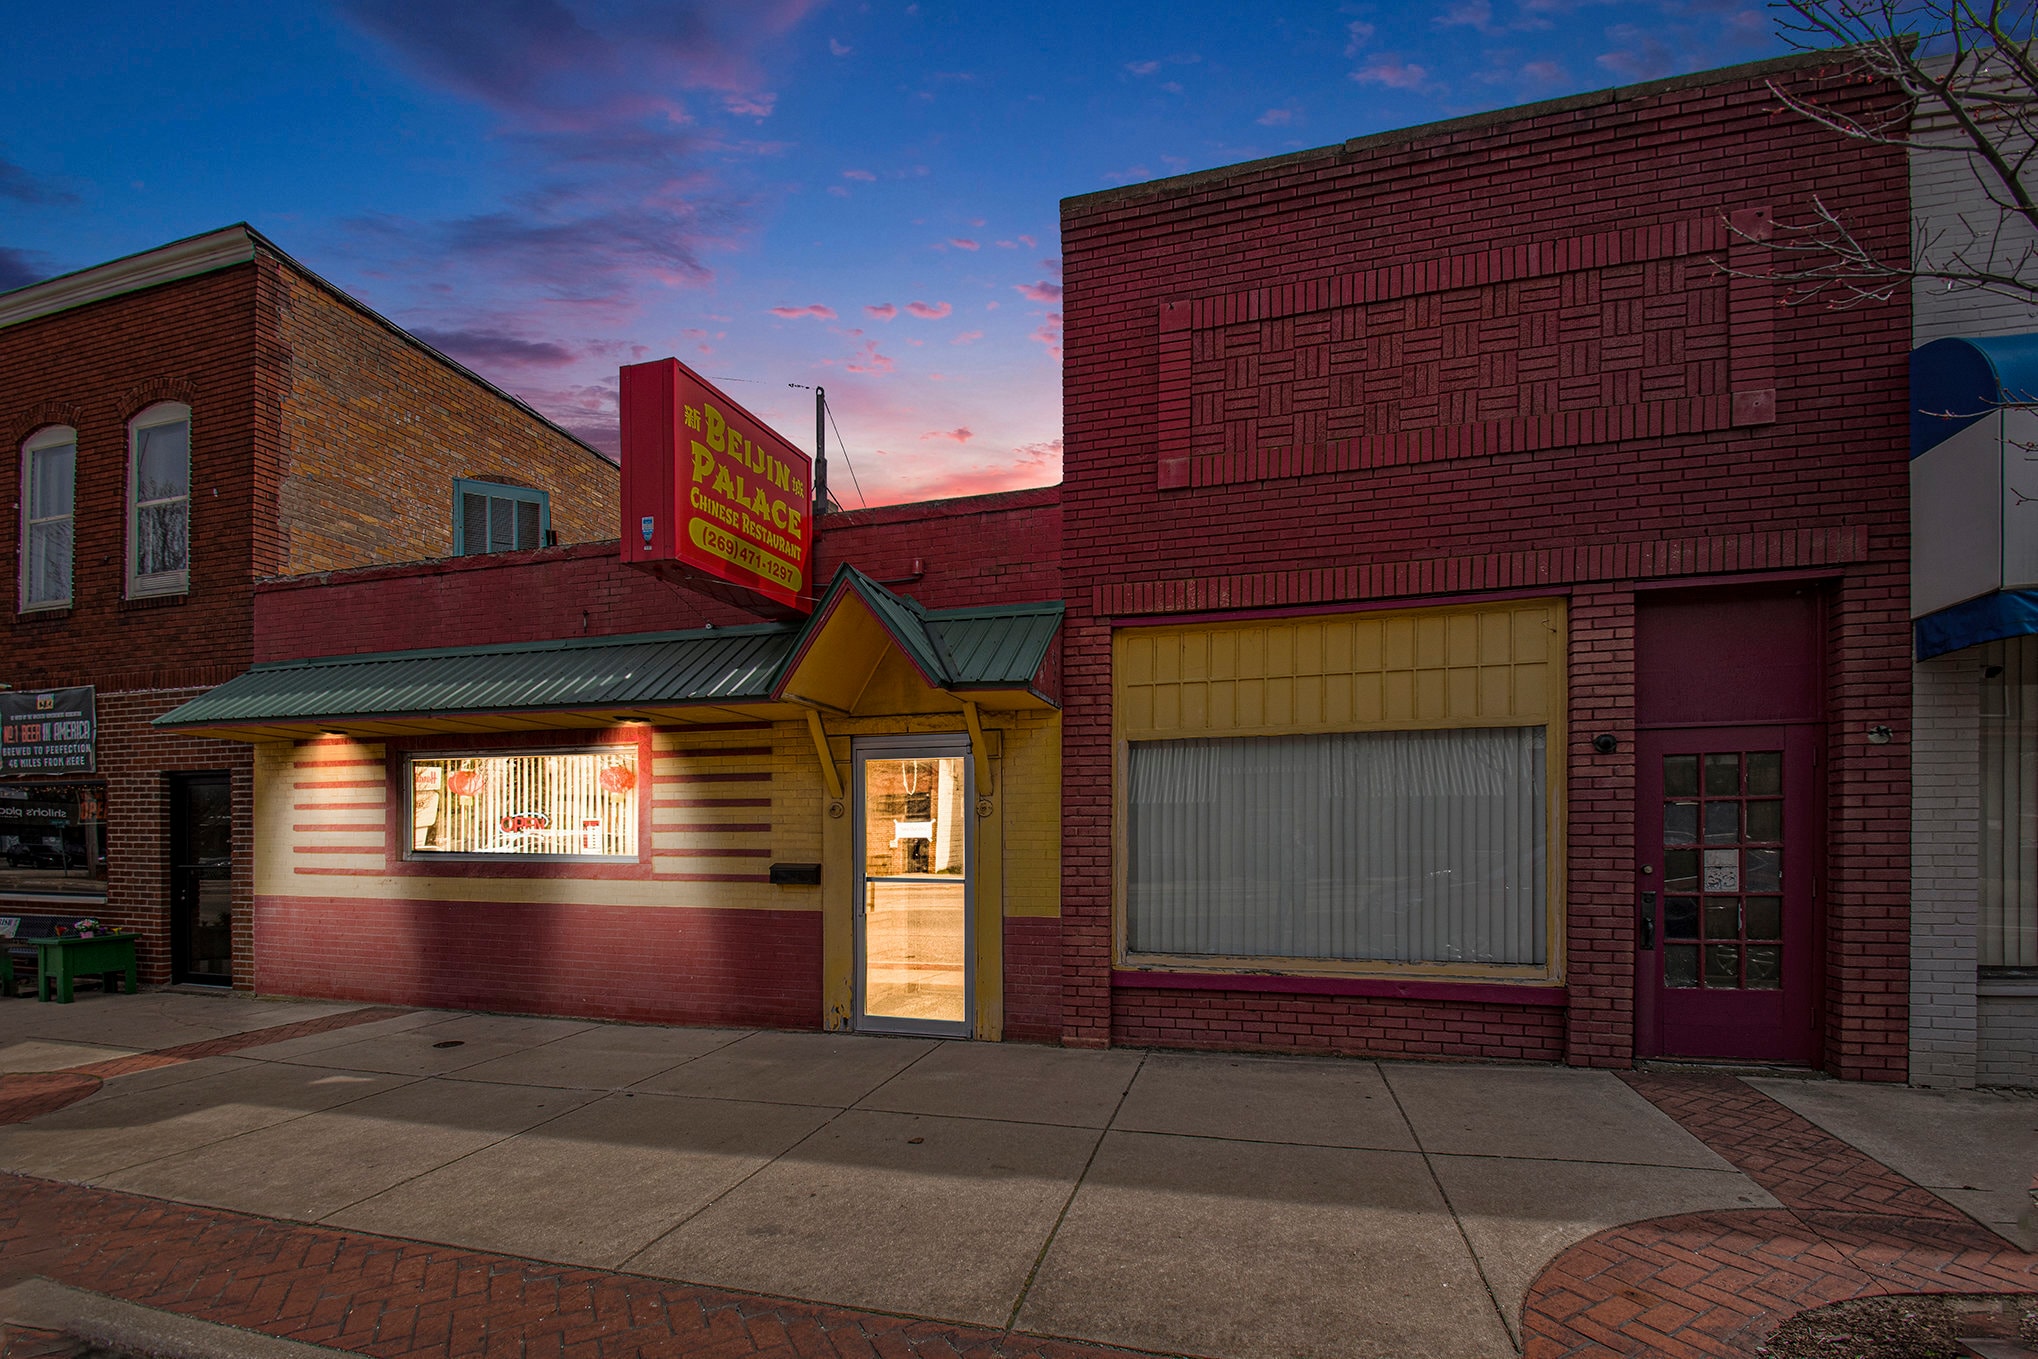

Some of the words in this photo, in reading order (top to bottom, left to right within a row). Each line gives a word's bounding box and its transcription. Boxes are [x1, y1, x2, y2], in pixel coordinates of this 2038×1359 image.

[704, 403, 790, 492] BEIJIN
[690, 440, 801, 540] PALACE
[690, 486, 739, 529] CHINESE
[741, 512, 802, 561] RESTAURANT
[53, 720, 91, 741] AMERICA
[2, 746, 31, 757] BREWED
[34, 745, 43, 755] TO
[45, 743, 91, 755] PERFECTION
[20, 758, 42, 768] MILES
[44, 757, 64, 767] FROM
[500, 816, 545, 833] OPEN
